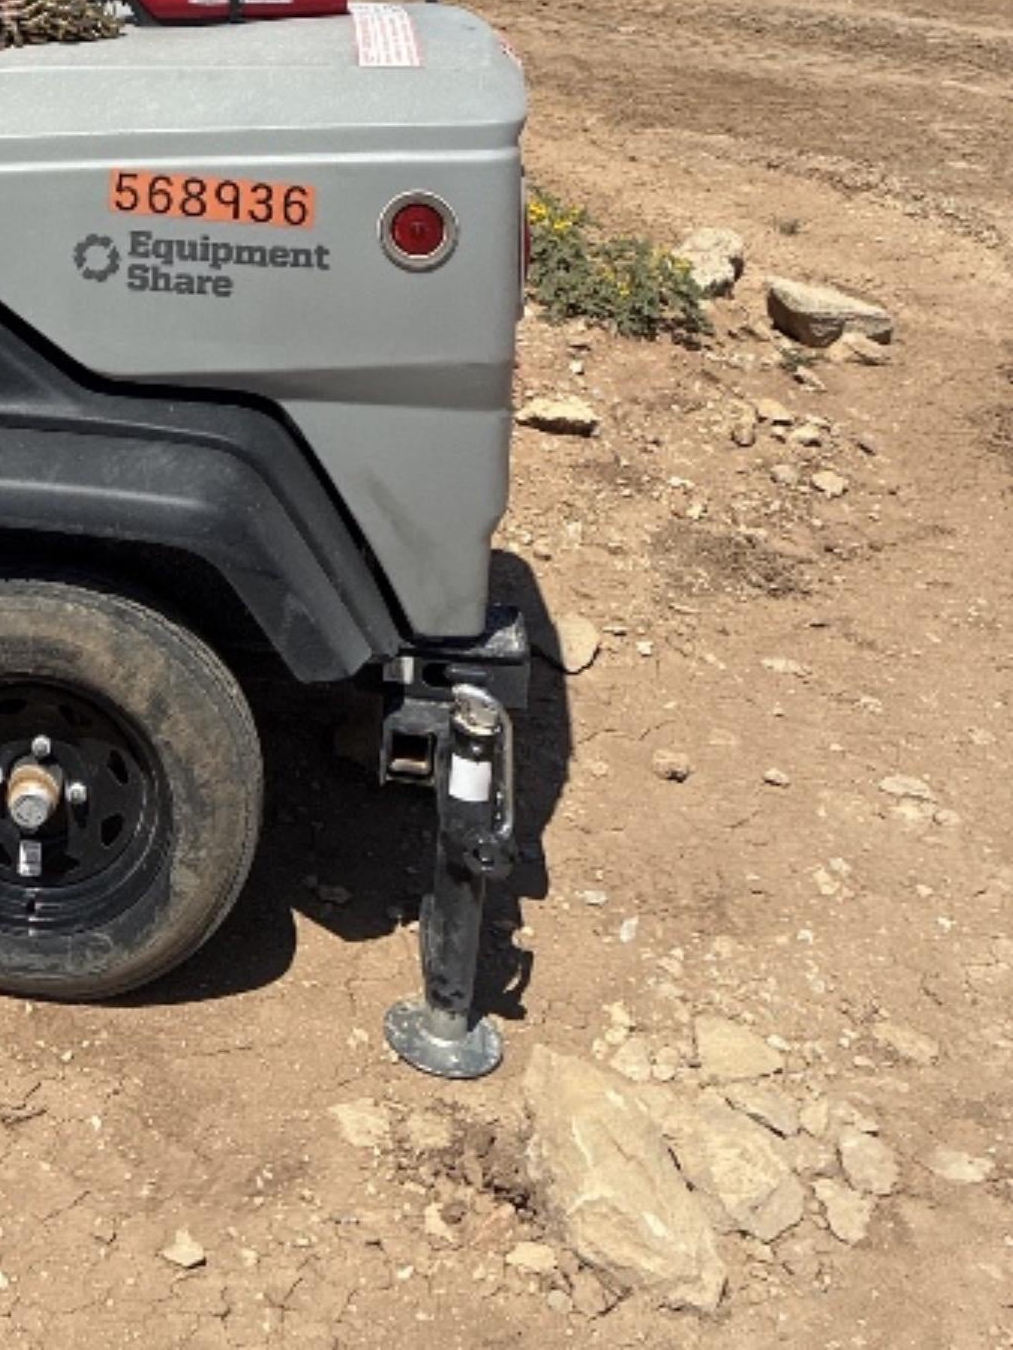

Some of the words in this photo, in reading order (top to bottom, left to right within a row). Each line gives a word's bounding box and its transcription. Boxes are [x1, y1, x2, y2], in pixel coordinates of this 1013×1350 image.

[114, 172, 308, 226] 568936
[127, 230, 330, 271] Equipment
[127, 263, 234, 297] Share
